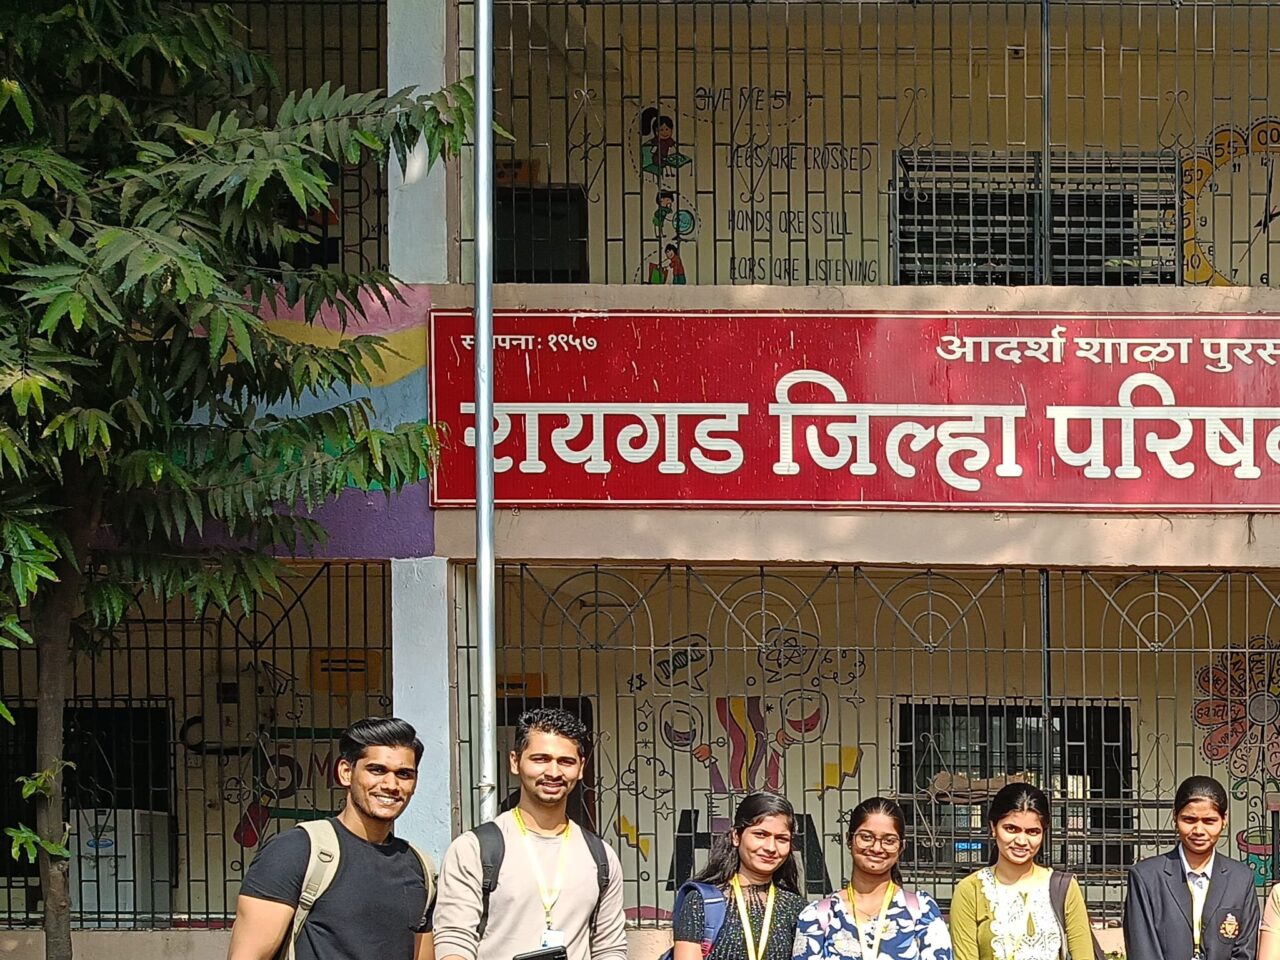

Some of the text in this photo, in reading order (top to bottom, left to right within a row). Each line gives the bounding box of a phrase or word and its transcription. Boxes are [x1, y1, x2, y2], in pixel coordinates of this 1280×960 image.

[936, 324, 1066, 365] आदर्श
[1075, 334, 1192, 364] शाळा
[460, 402, 749, 474] रायगड
[769, 369, 1026, 492] जिल्हा
